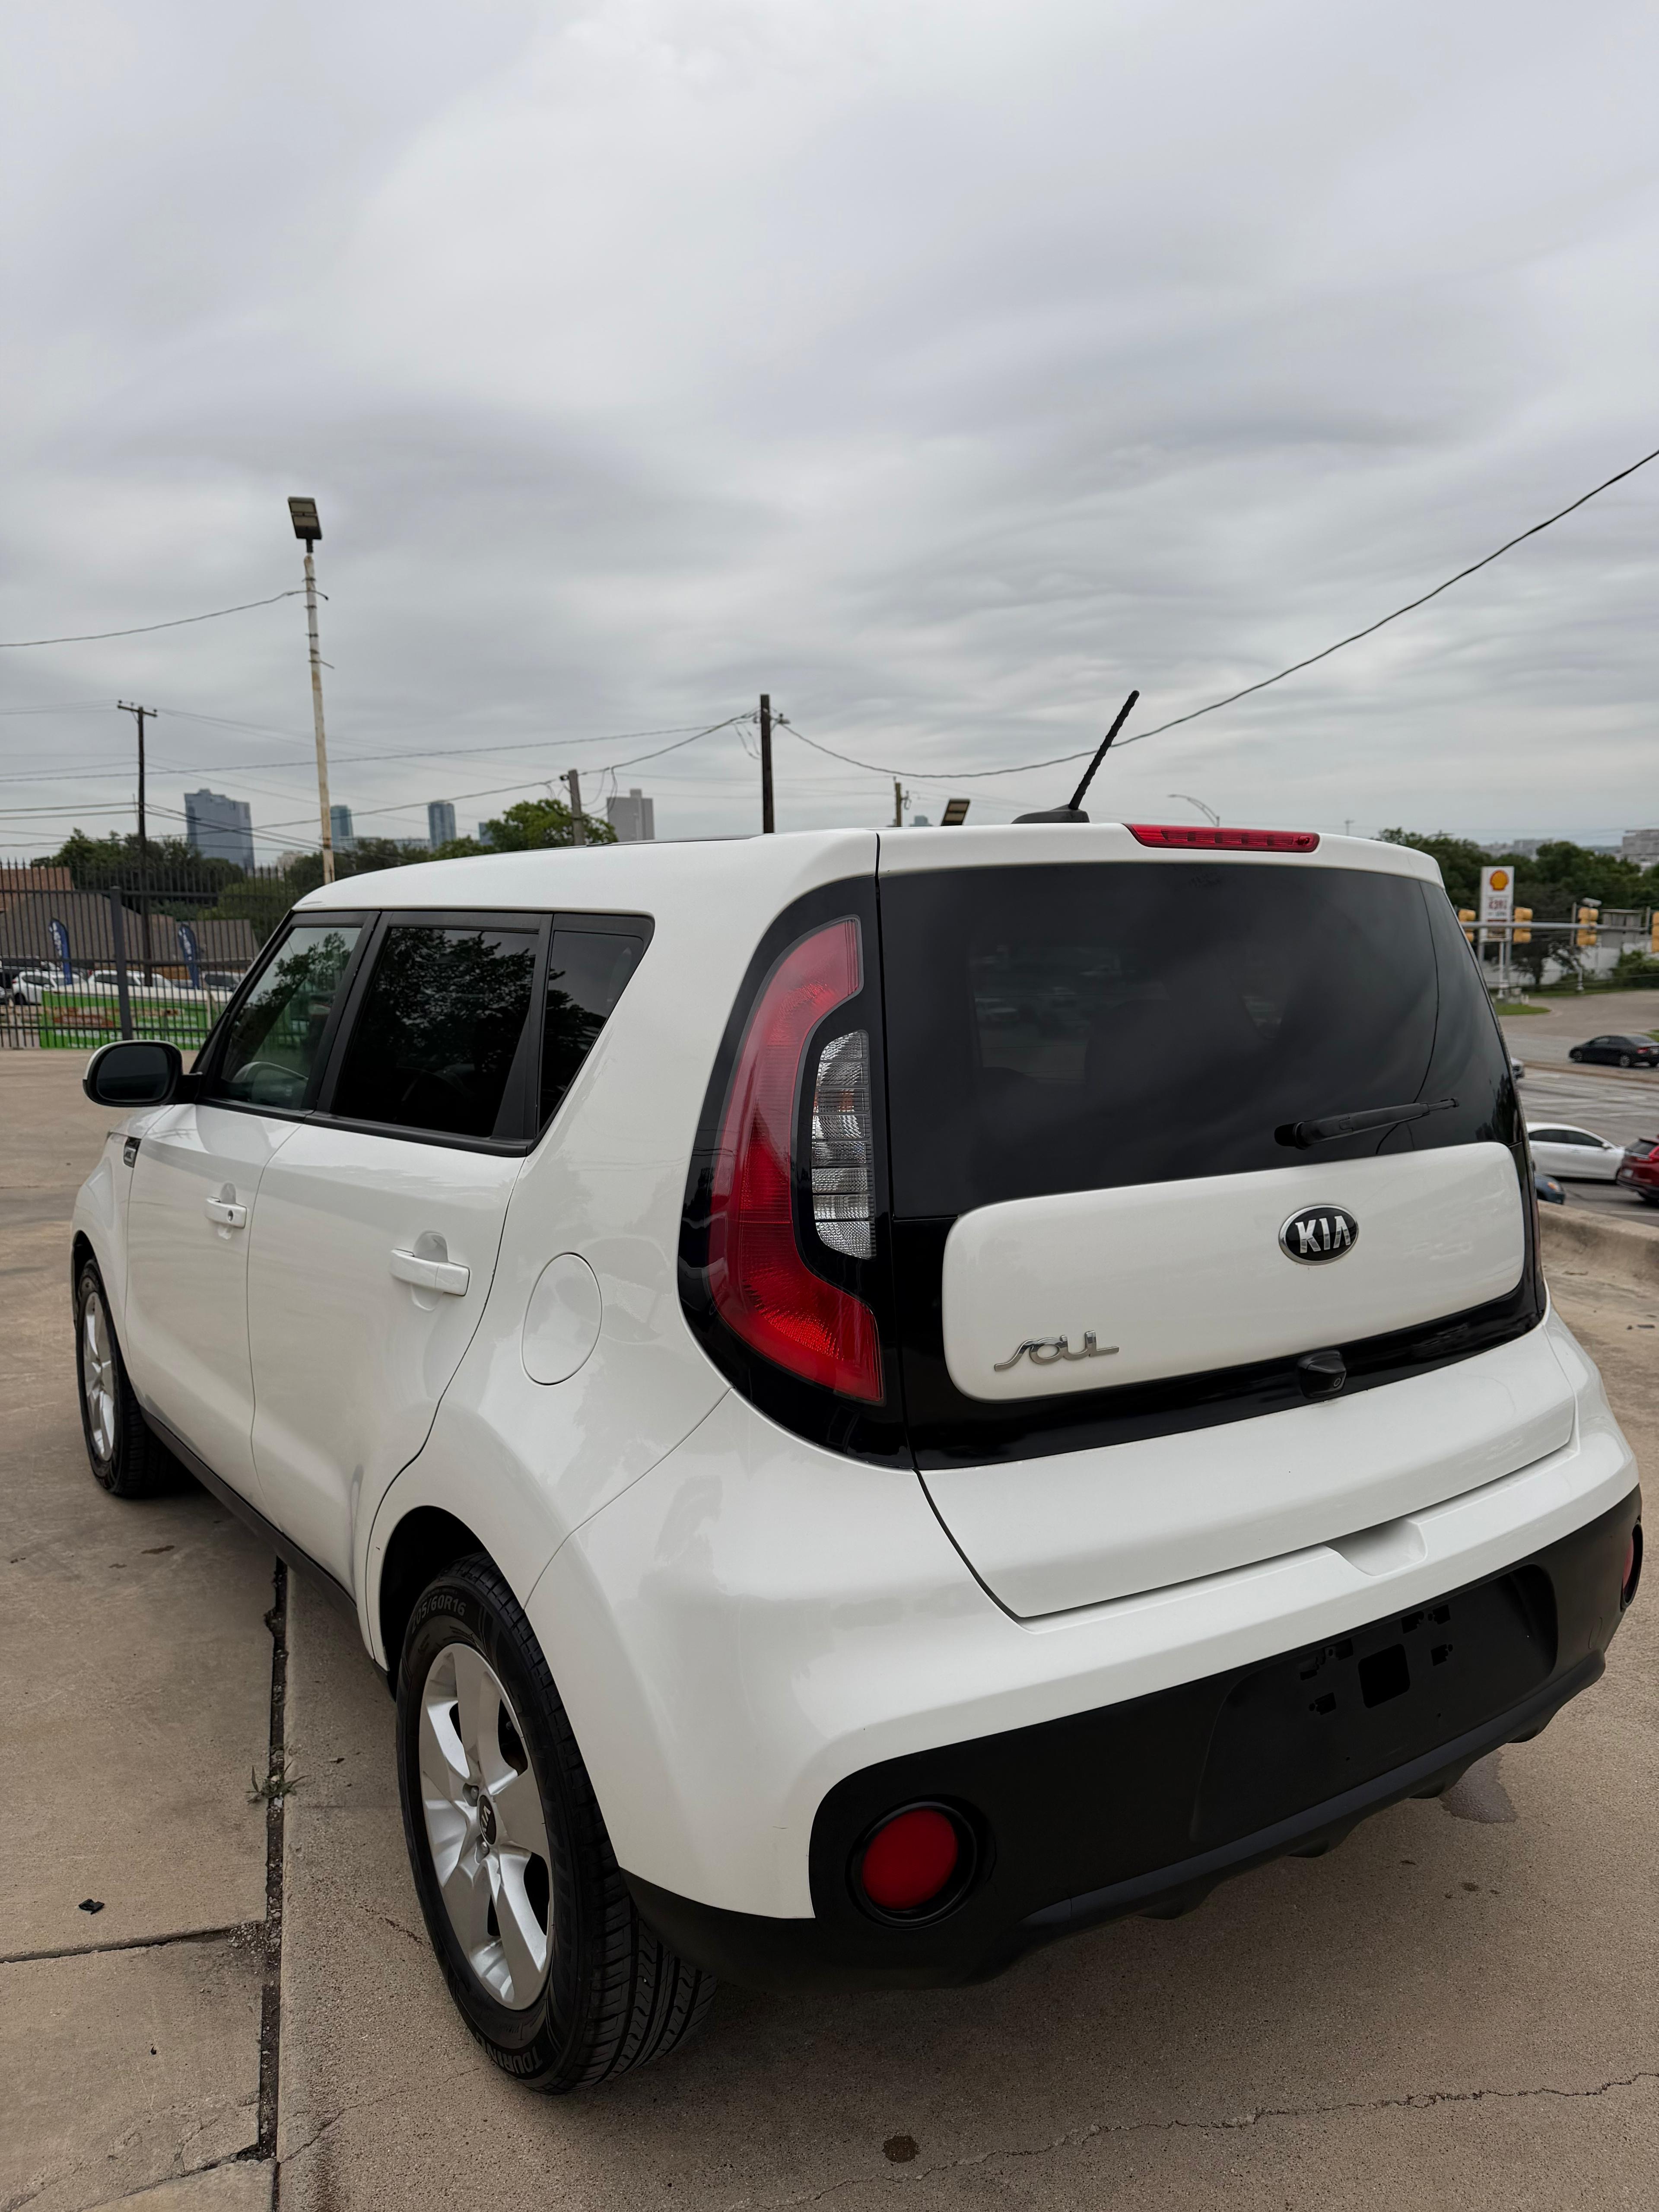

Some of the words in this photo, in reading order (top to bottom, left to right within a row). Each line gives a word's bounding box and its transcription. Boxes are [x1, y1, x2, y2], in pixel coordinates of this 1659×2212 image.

[1295, 1215, 1351, 1253] KIA
[412, 1594, 467, 1634] 205/60R16
[476, 2032, 543, 2074] TOURING
